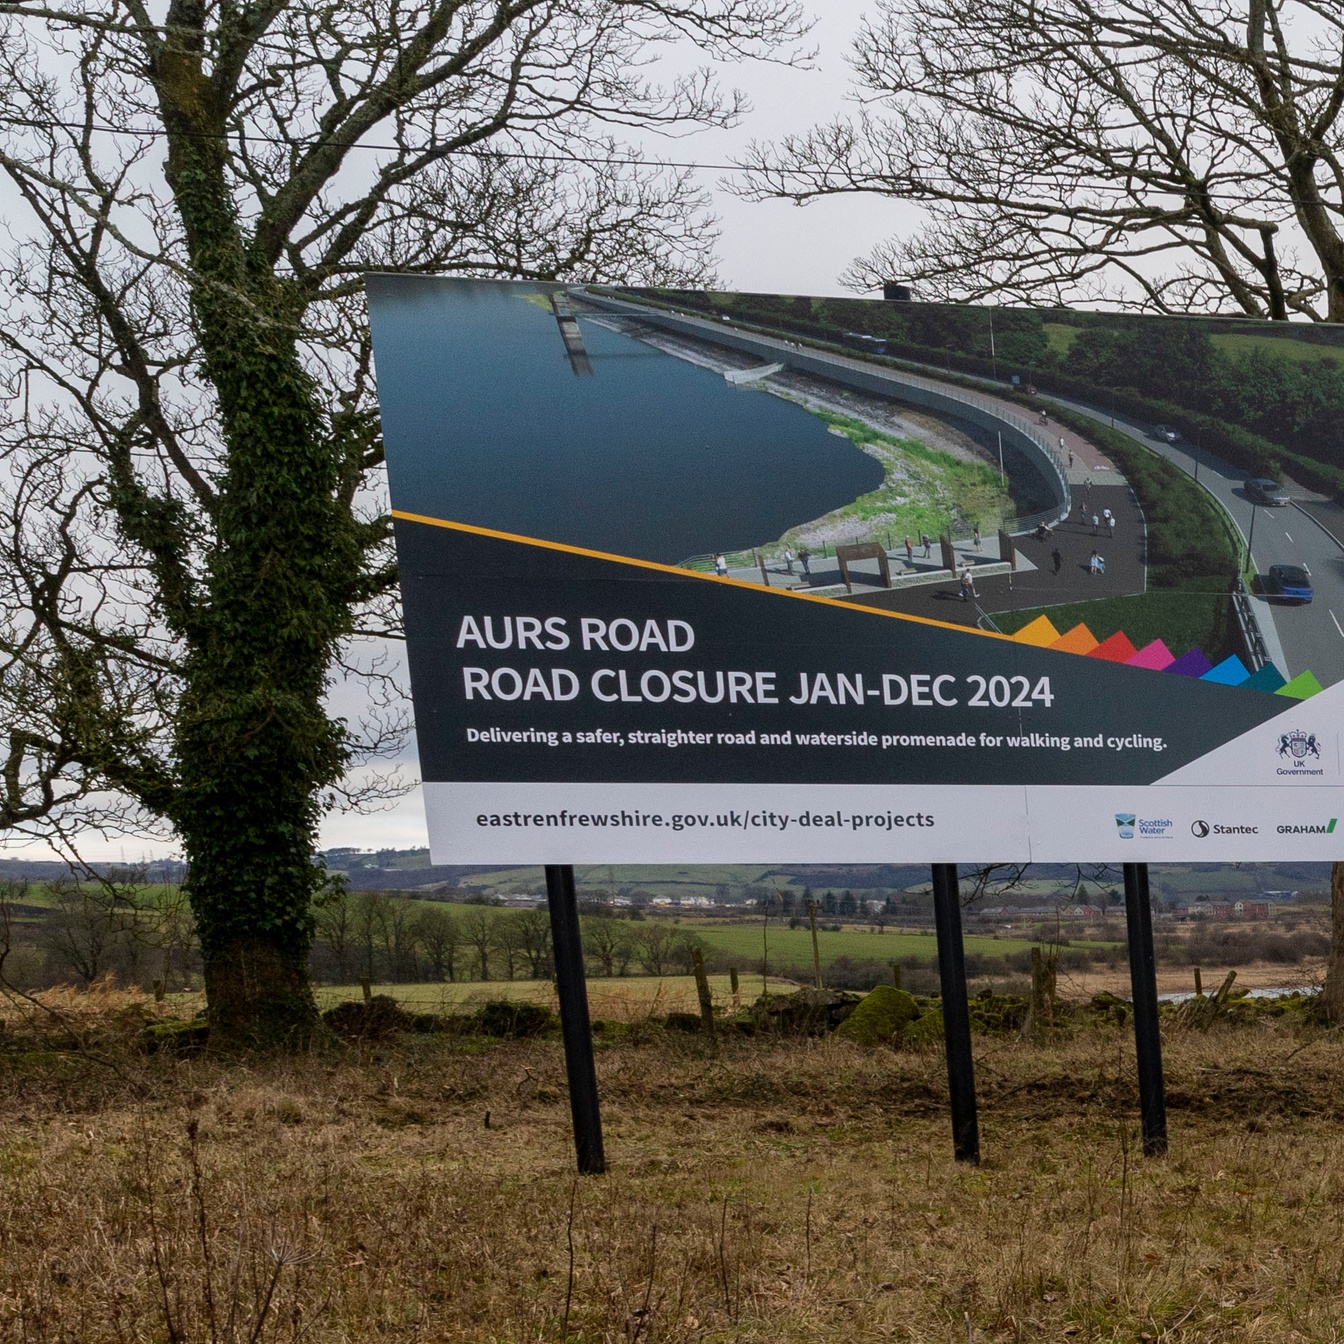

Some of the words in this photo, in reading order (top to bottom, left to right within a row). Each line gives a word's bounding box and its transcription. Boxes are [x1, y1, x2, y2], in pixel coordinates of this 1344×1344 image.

[456, 615, 571, 651] AURS
[580, 617, 696, 652] ROAD
[462, 666, 580, 702] ROAD
[590, 669, 780, 705] CLOSURE
[789, 672, 959, 707] JAN-DEC
[965, 674, 1055, 708] 2024
[466, 727, 559, 746] Delivering
[561, 732, 573, 744] a
[575, 728, 625, 747] safer,
[627, 729, 714, 748] straighter
[716, 730, 757, 745] road
[759, 730, 792, 745] and
[795, 731, 878, 747] waterside
[881, 732, 977, 749] promenade
[978, 732, 1004, 748] for
[1005, 732, 1071, 751] walking
[1073, 733, 1104, 749] and
[1106, 733, 1168, 752] cycling.
[1293, 760, 1306, 769] UK
[1276, 768, 1324, 777] Government
[476, 808, 936, 831] eastrenfrewshire.gov.uk/city-deal-projects
[1138, 818, 1173, 828] Scottish
[1138, 826, 1166, 835] Water
[1213, 823, 1259, 835] Stantec
[1276, 824, 1326, 835] GRAHAM
